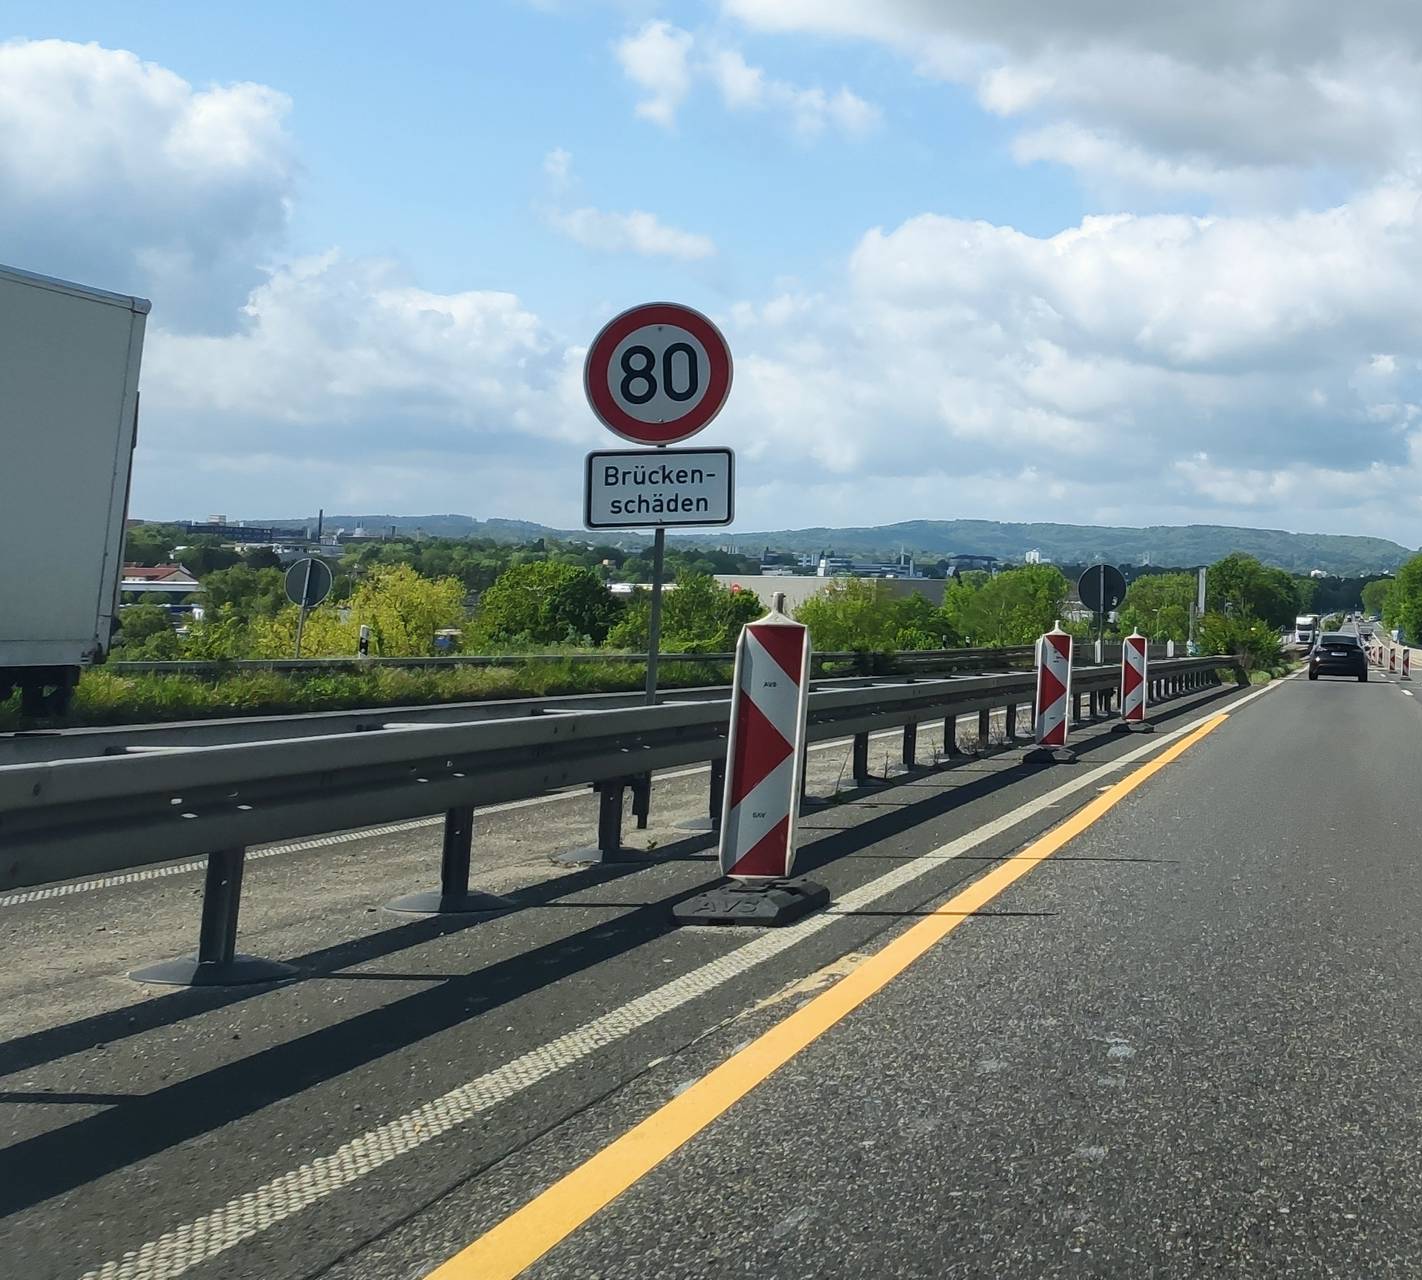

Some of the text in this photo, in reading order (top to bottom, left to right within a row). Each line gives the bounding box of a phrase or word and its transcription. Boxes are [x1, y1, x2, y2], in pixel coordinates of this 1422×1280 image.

[620, 342, 699, 405] 80
[604, 464, 716, 487] Brücken-
[610, 493, 709, 515] schäden
